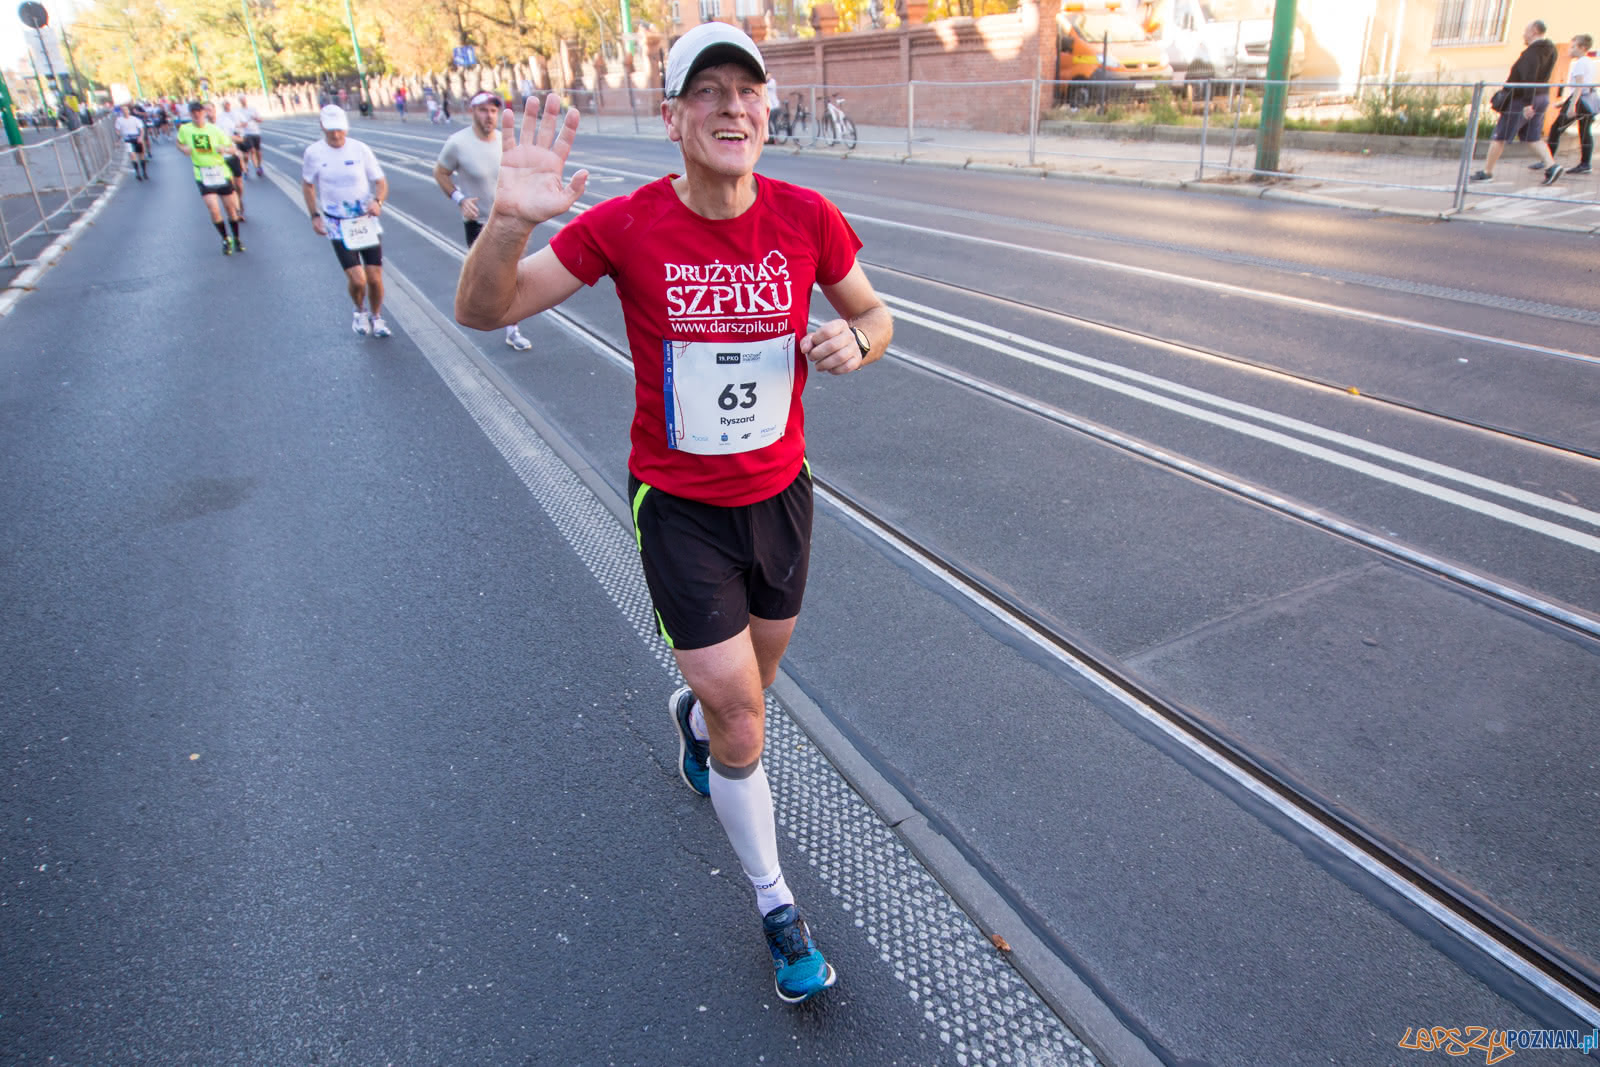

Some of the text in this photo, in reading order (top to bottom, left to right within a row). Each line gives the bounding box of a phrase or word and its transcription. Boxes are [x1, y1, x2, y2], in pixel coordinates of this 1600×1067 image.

[664, 259, 770, 282] DRUŻYNA
[666, 281, 793, 317] SZPIKU
[671, 319, 788, 335] www.darszpiku.pl
[718, 382, 757, 410] 63
[720, 414, 755, 426] Ryszard
